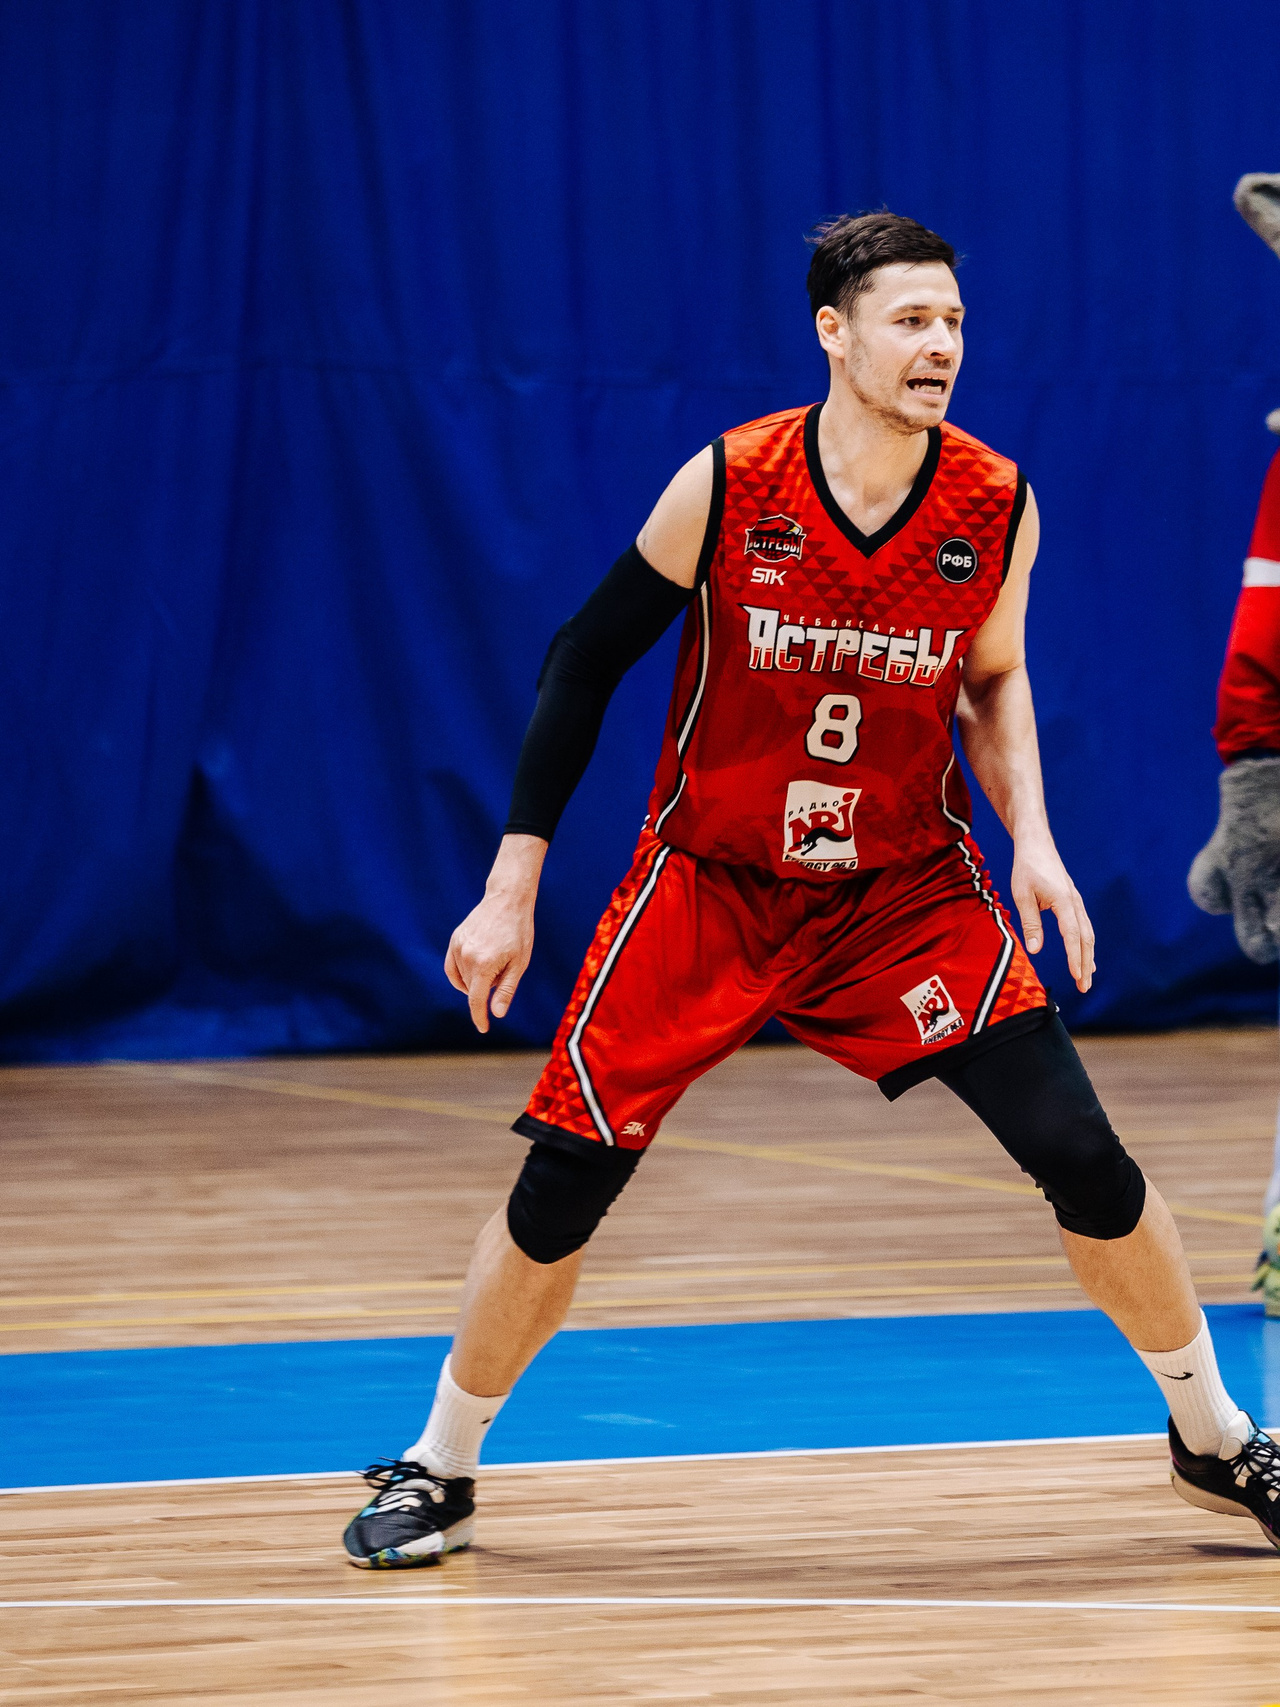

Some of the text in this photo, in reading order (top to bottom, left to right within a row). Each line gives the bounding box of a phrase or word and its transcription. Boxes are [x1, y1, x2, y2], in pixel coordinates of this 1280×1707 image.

[942, 554, 972, 568] РФБ
[750, 567, 787, 586] STK
[783, 614, 914, 638] ЧЕБОКСАРЫ
[742, 603, 964, 687] ЯСТРЕБЫ
[806, 694, 861, 763] 8
[788, 801, 840, 818] РАДИО
